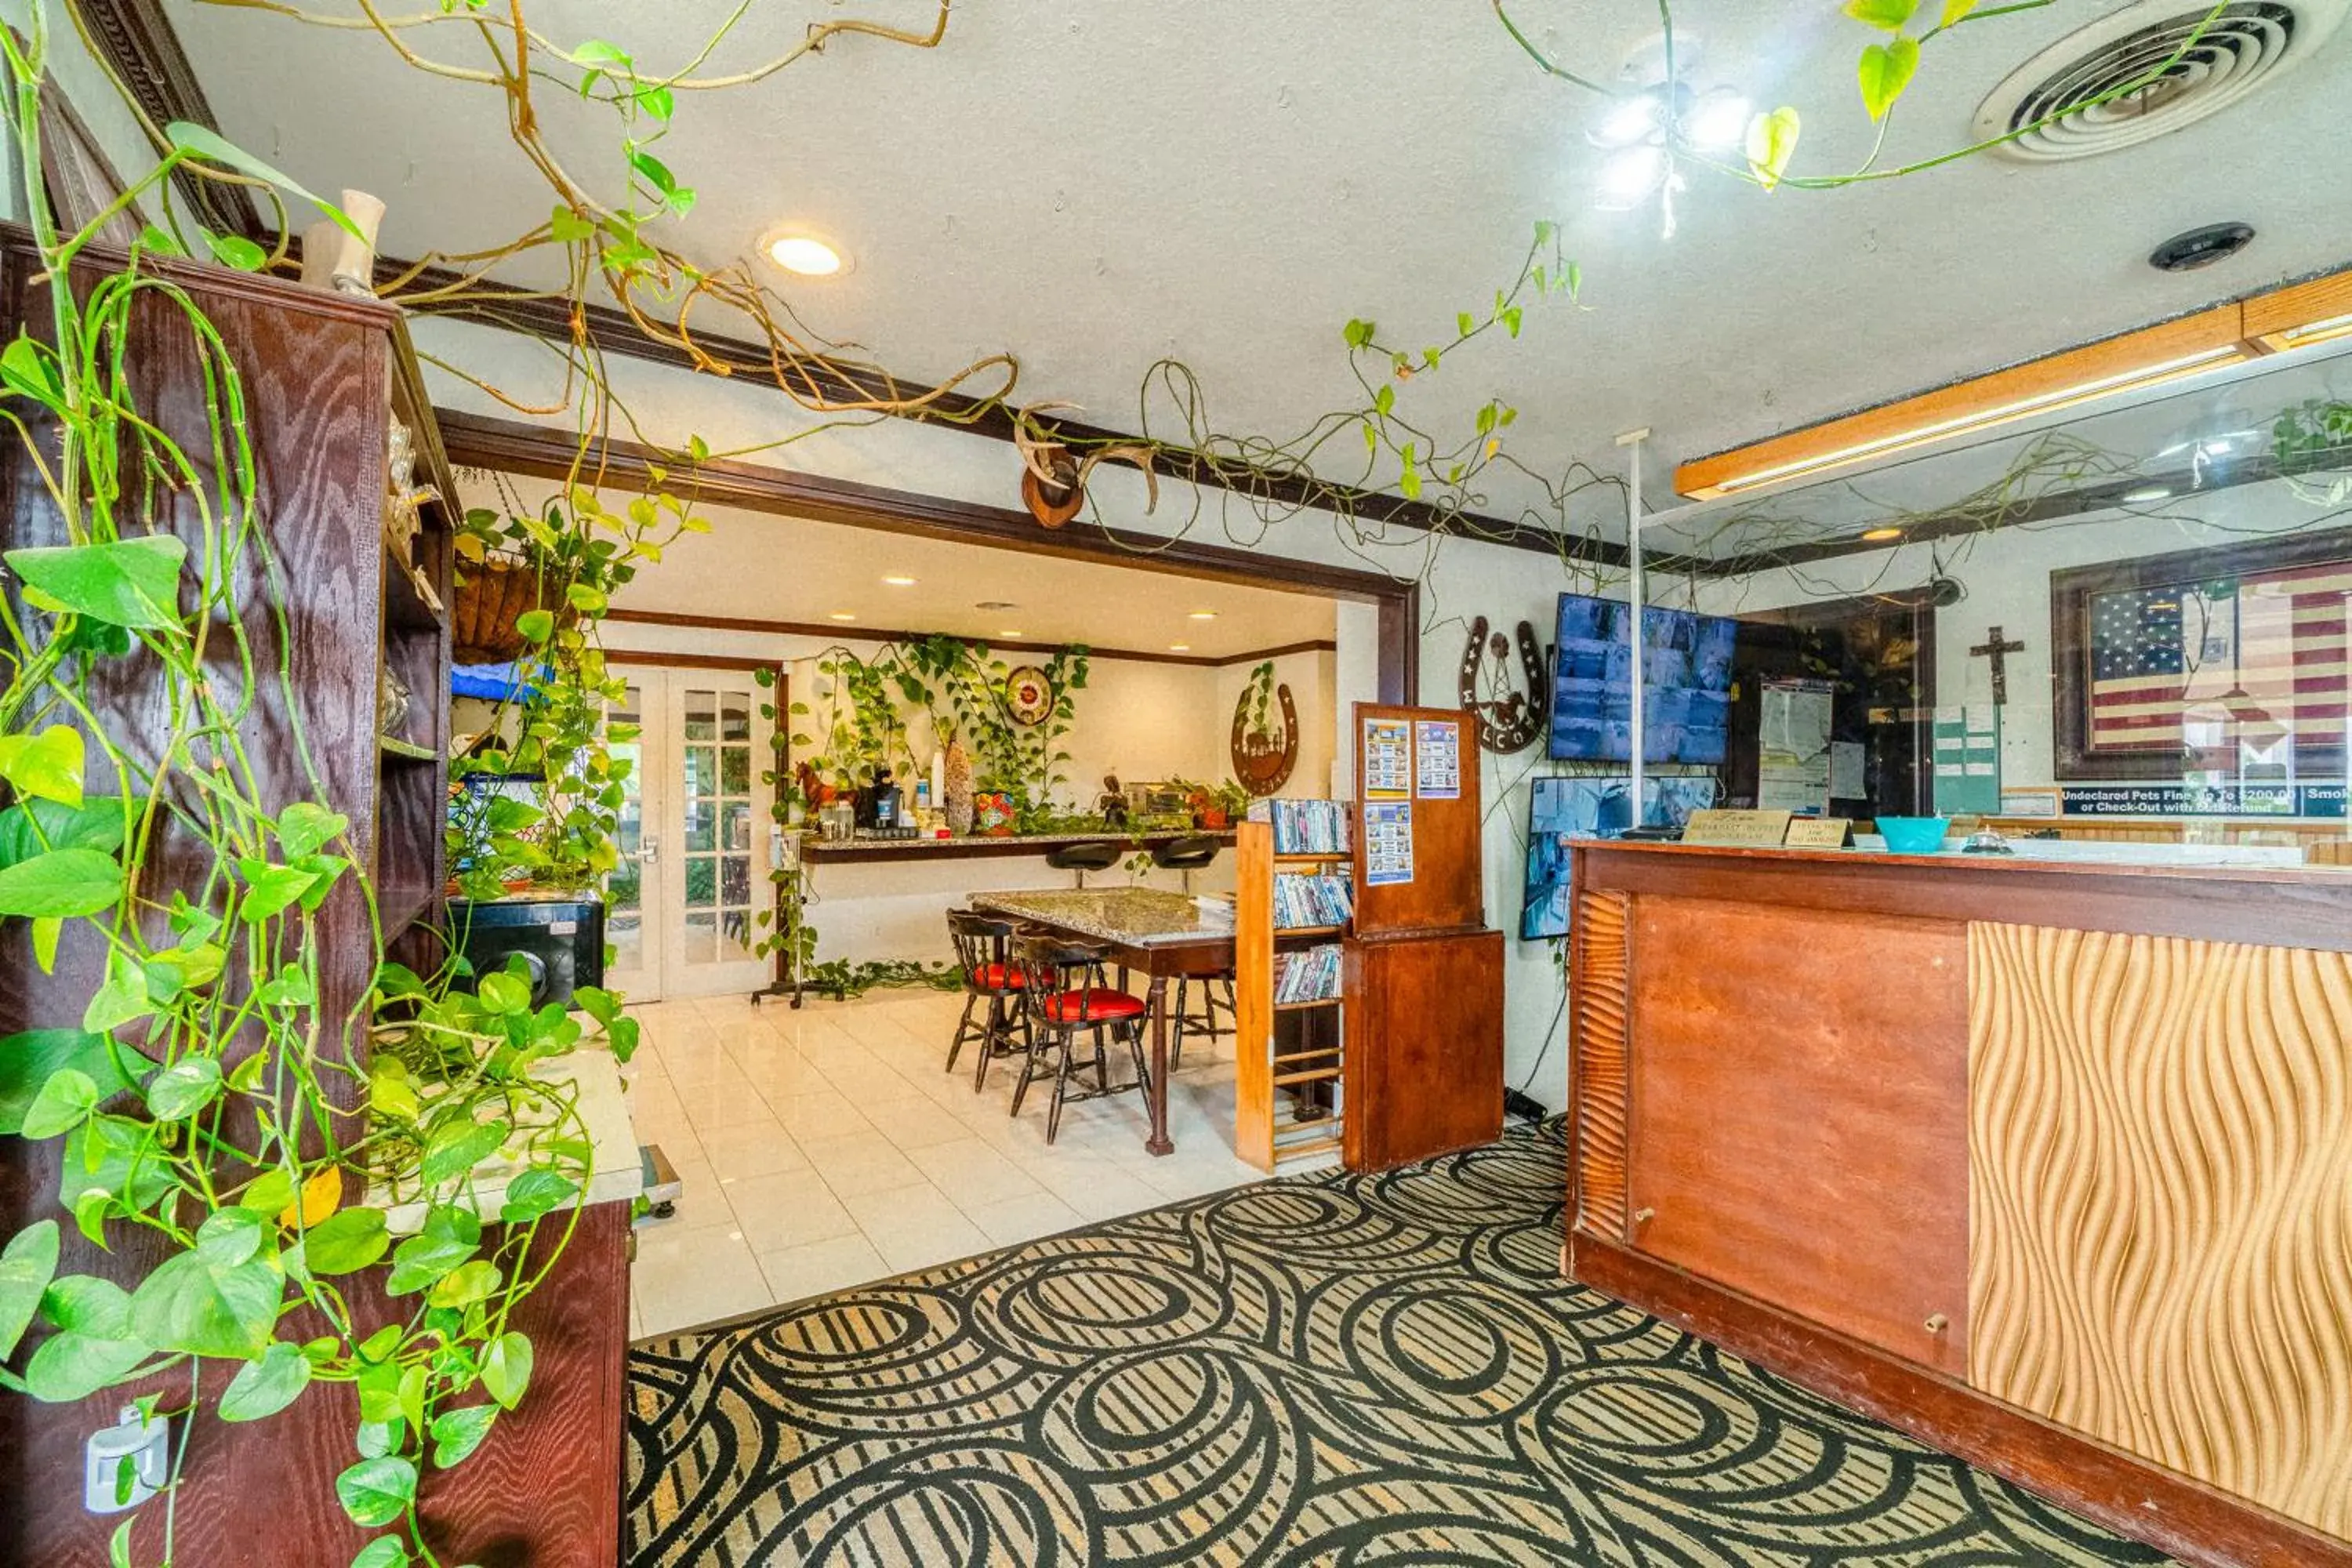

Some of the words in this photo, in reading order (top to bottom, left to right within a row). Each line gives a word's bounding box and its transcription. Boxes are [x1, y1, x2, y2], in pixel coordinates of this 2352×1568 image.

[1462, 689, 1541, 749] WLCOE
[2062, 790, 2128, 800] Undeclared
[2132, 790, 2161, 800] Pets
[2163, 790, 2192, 800] Fine
[2096, 802, 2161, 812] Check-Out
